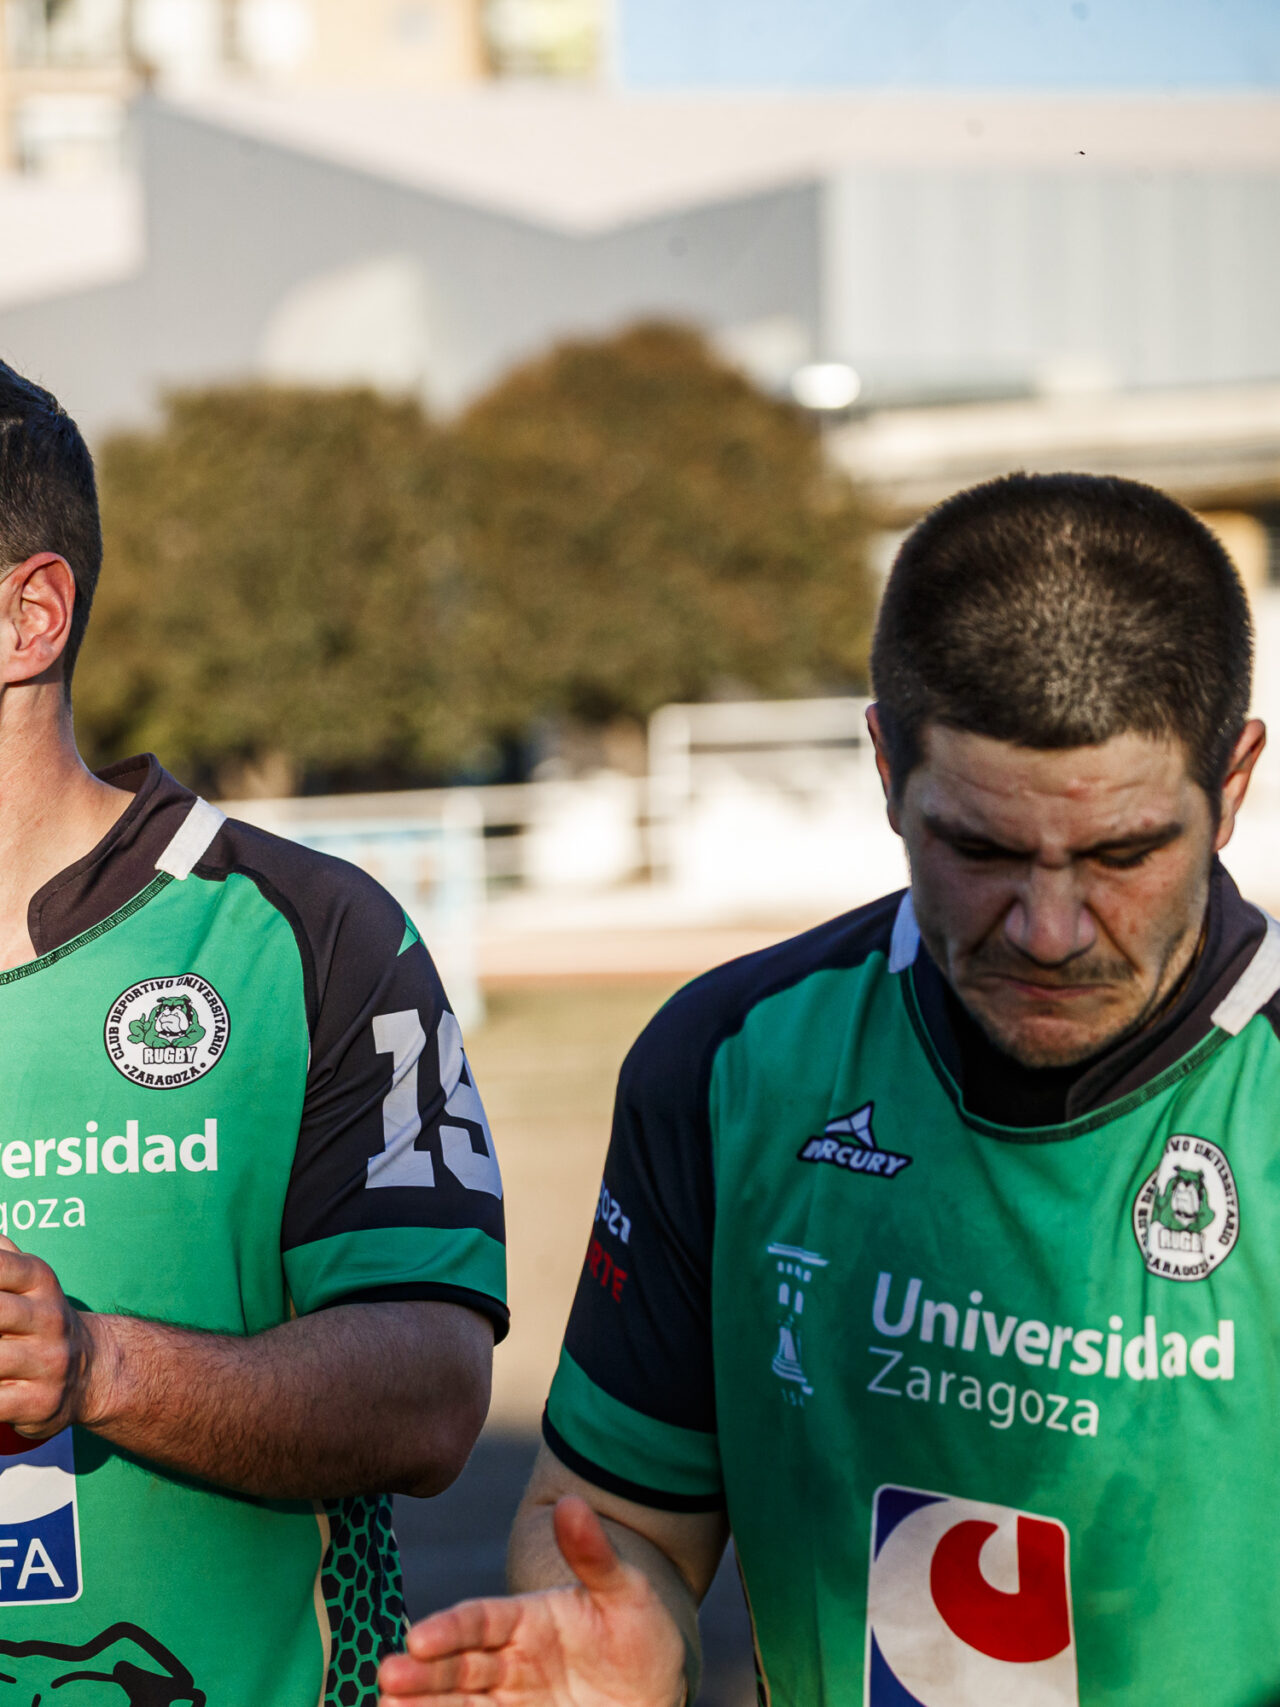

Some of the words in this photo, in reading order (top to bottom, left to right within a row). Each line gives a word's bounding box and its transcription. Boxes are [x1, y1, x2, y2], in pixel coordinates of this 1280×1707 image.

[110, 979, 173, 1024] DEPORTIVO
[176, 976, 226, 1056] UNIVERSITARIO
[109, 1027, 124, 1060] CLUB
[143, 1047, 197, 1064] RUGBY
[128, 1066, 201, 1086] ZARAGOZA
[873, 1272, 1235, 1381] Universidad
[867, 1346, 1100, 1437] Zaragoza
